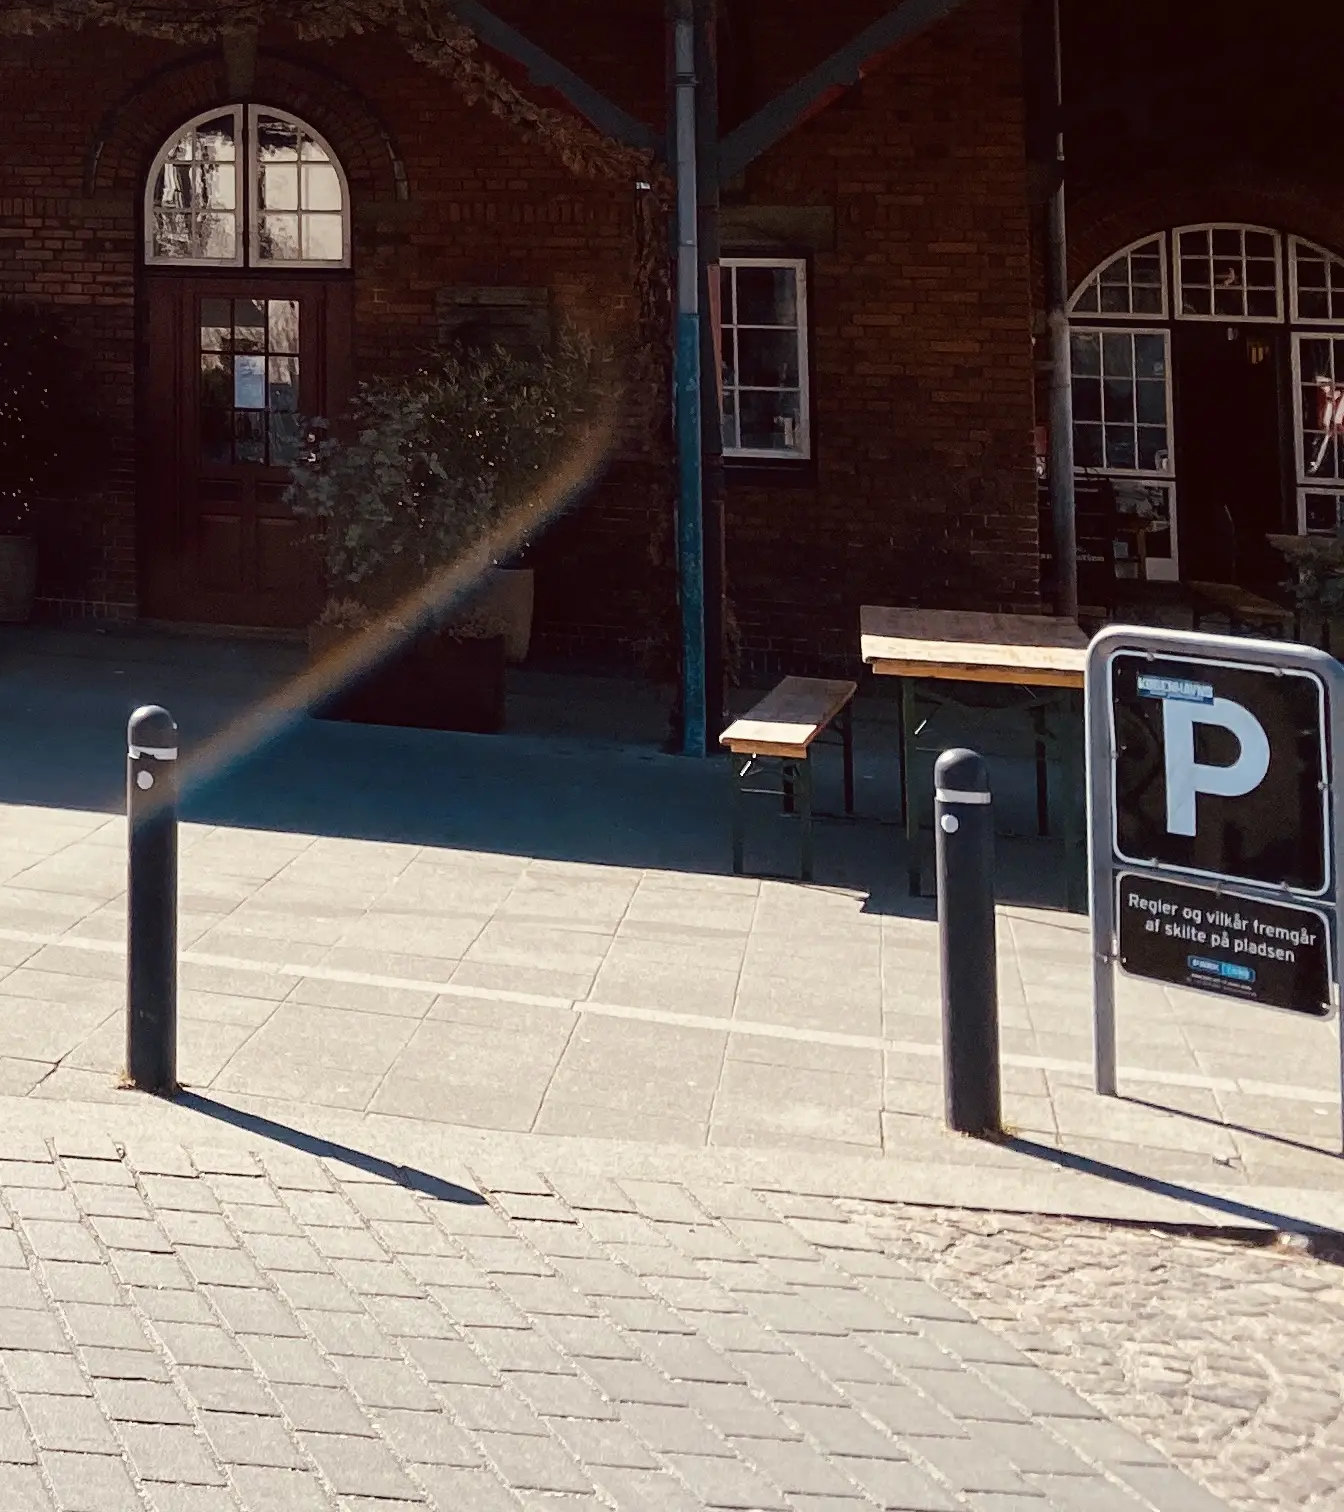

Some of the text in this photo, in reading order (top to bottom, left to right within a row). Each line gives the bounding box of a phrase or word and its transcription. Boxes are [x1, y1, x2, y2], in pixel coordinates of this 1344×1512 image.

[1162, 696, 1270, 837] P
[1128, 893, 1317, 947] Regler og vilkår fremgår
[1144, 917, 1295, 963] af skilte på pladsen
